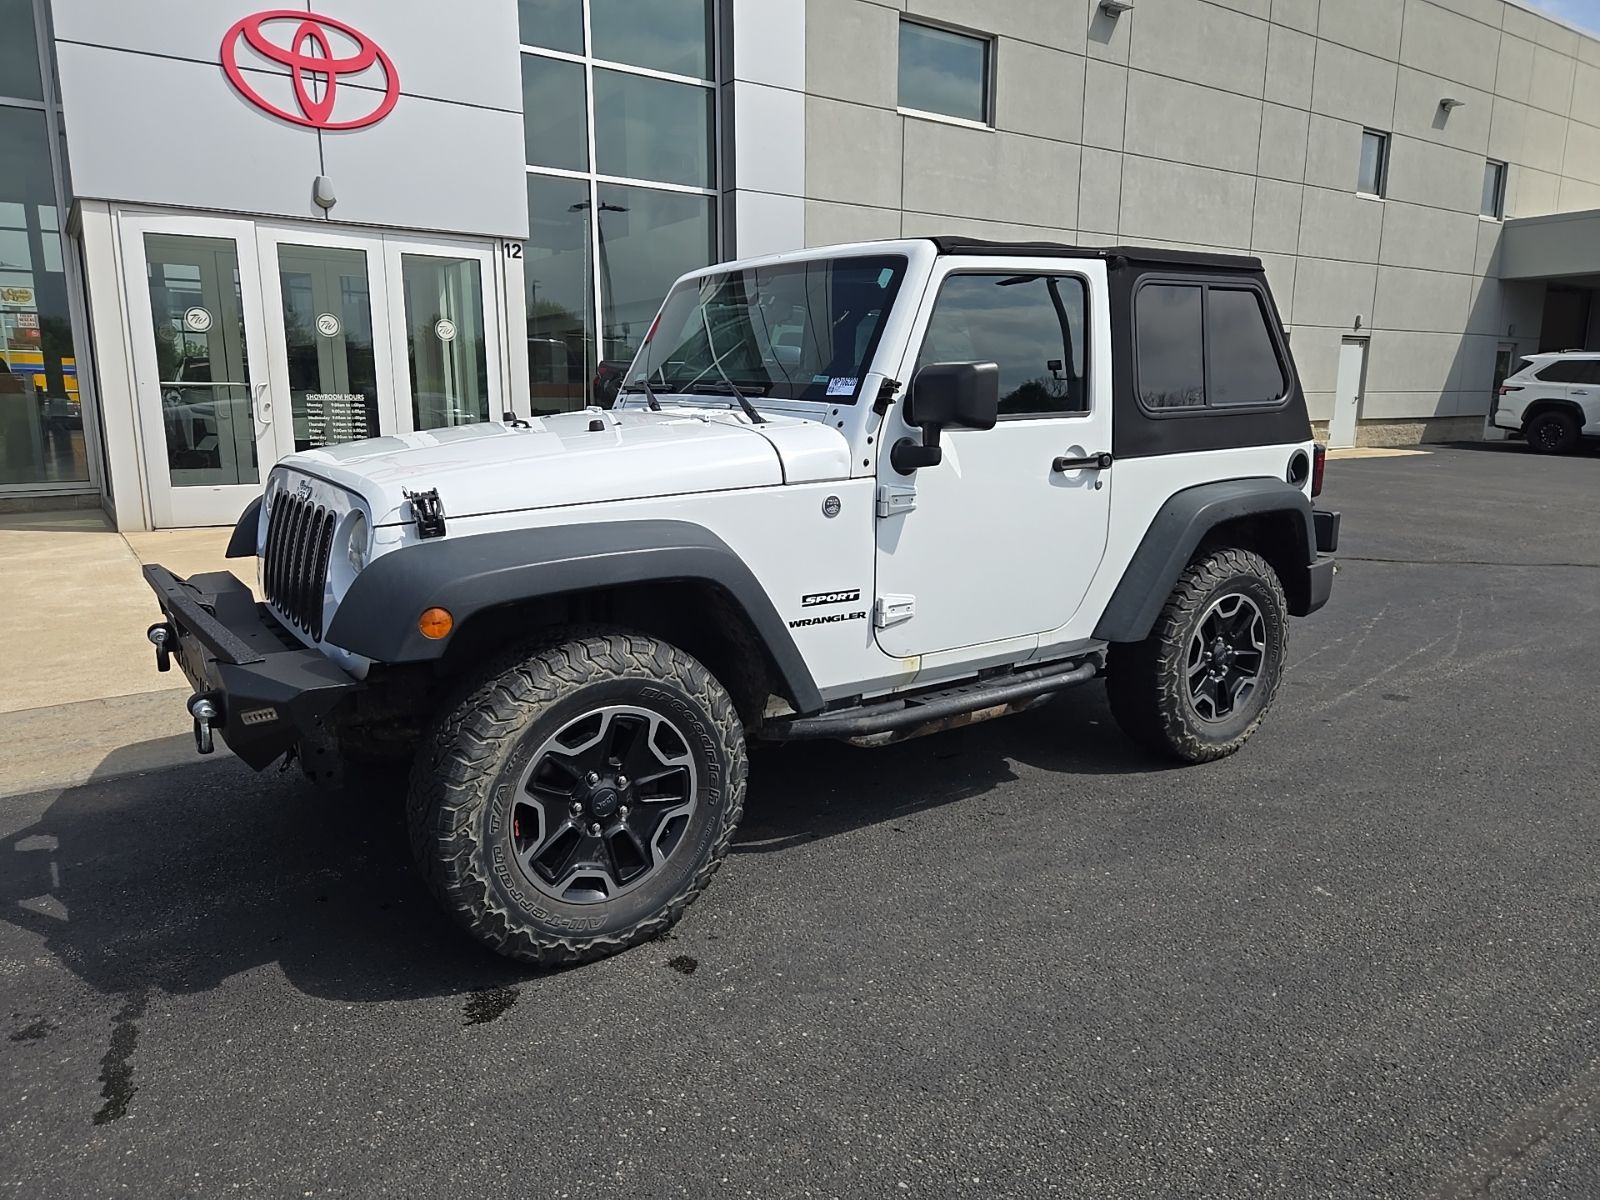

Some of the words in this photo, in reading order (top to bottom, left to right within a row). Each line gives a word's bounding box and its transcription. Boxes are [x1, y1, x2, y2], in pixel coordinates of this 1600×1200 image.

[505, 243, 522, 259] 12
[305, 393, 343, 401] SHOWROOM
[802, 590, 860, 606] SPORT
[788, 611, 866, 628] WRANGLER
[640, 686, 720, 807] BFGoodrich
[490, 784, 509, 834] T/A
[492, 845, 609, 930] All-Terrain
